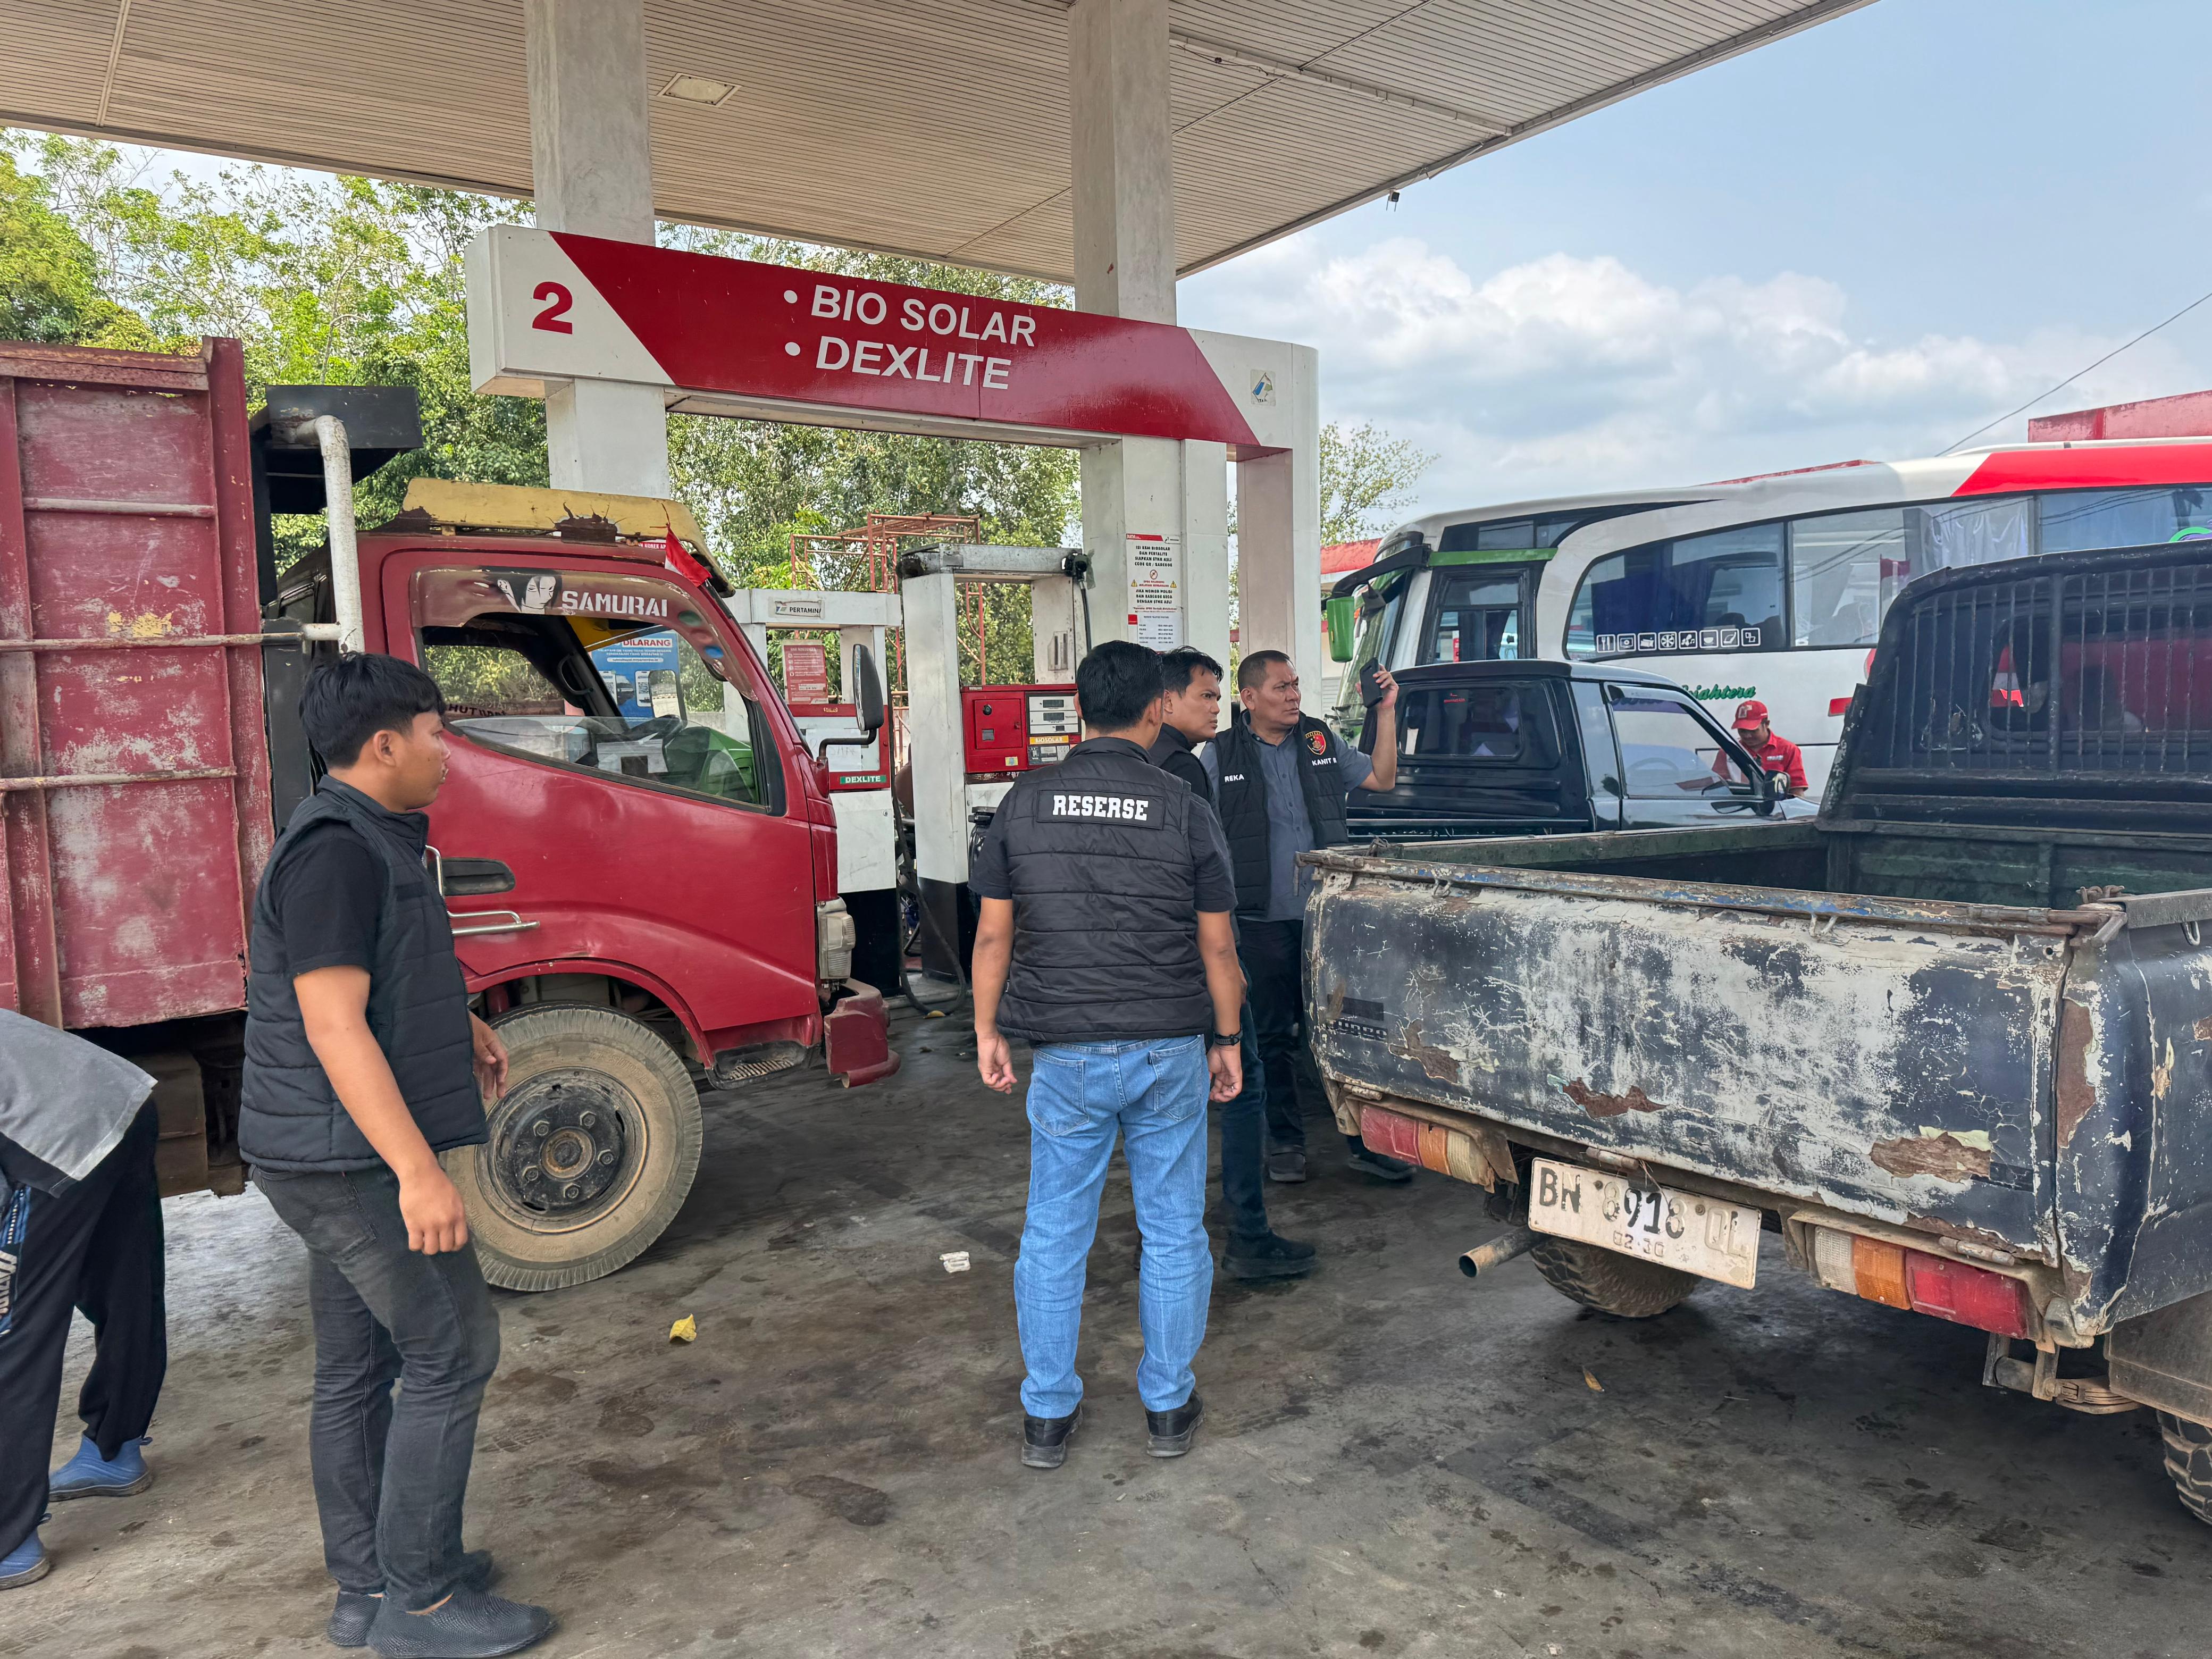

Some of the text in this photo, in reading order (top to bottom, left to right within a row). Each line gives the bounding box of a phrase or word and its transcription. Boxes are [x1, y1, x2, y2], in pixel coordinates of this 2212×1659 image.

[532, 281, 573, 334] 2
[811, 284, 1036, 347] BIO SOLAR
[816, 336, 1012, 390] DEXLITE
[562, 590, 667, 617] SAMURAI
[1225, 774, 1244, 782] REKA
[1052, 795, 1149, 821] RESERSE
[1602, 1181, 1688, 1239] 8918
